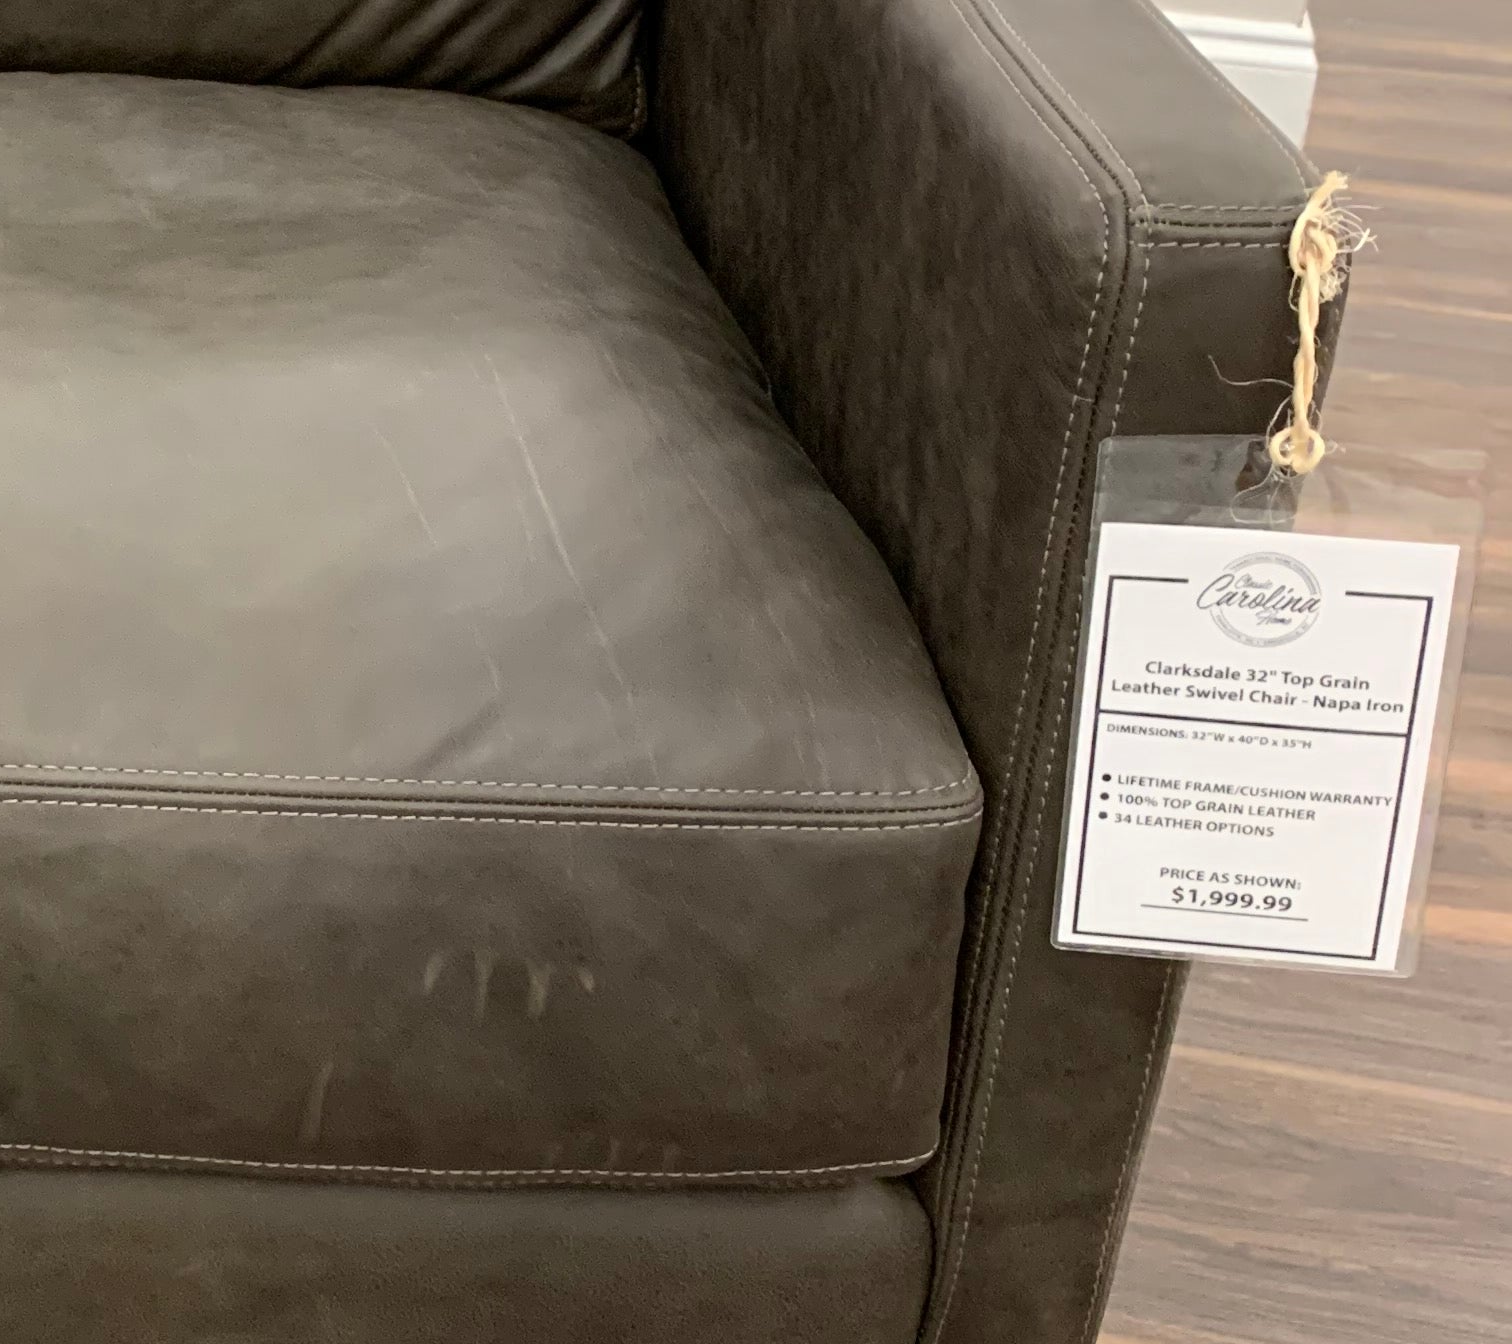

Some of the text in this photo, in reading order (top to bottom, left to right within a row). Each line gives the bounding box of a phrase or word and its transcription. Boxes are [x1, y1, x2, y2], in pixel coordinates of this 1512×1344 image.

[1196, 573, 1321, 613] Carolina
[1145, 661, 1370, 690] Clarksdale 32" Top Grain
[1111, 679, 1181, 697] Leather
[1185, 685, 1244, 702] Swivel
[1249, 690, 1297, 706] Chair
[1313, 695, 1361, 712] Napa
[1366, 699, 1404, 713] Iron
[1106, 723, 1189, 740] DIMENSIONS:
[1117, 774, 1393, 807] LIFETIME FRAME/CUSHION WARRANTY
[1118, 794, 1316, 821] 100% TOP GRAIN LEATHER
[1114, 813, 1275, 837] 34 LEATHER OPTIONS
[1159, 867, 1301, 891] PRICE AS SHOWN:
[1171, 885, 1293, 912] $1,999.99
